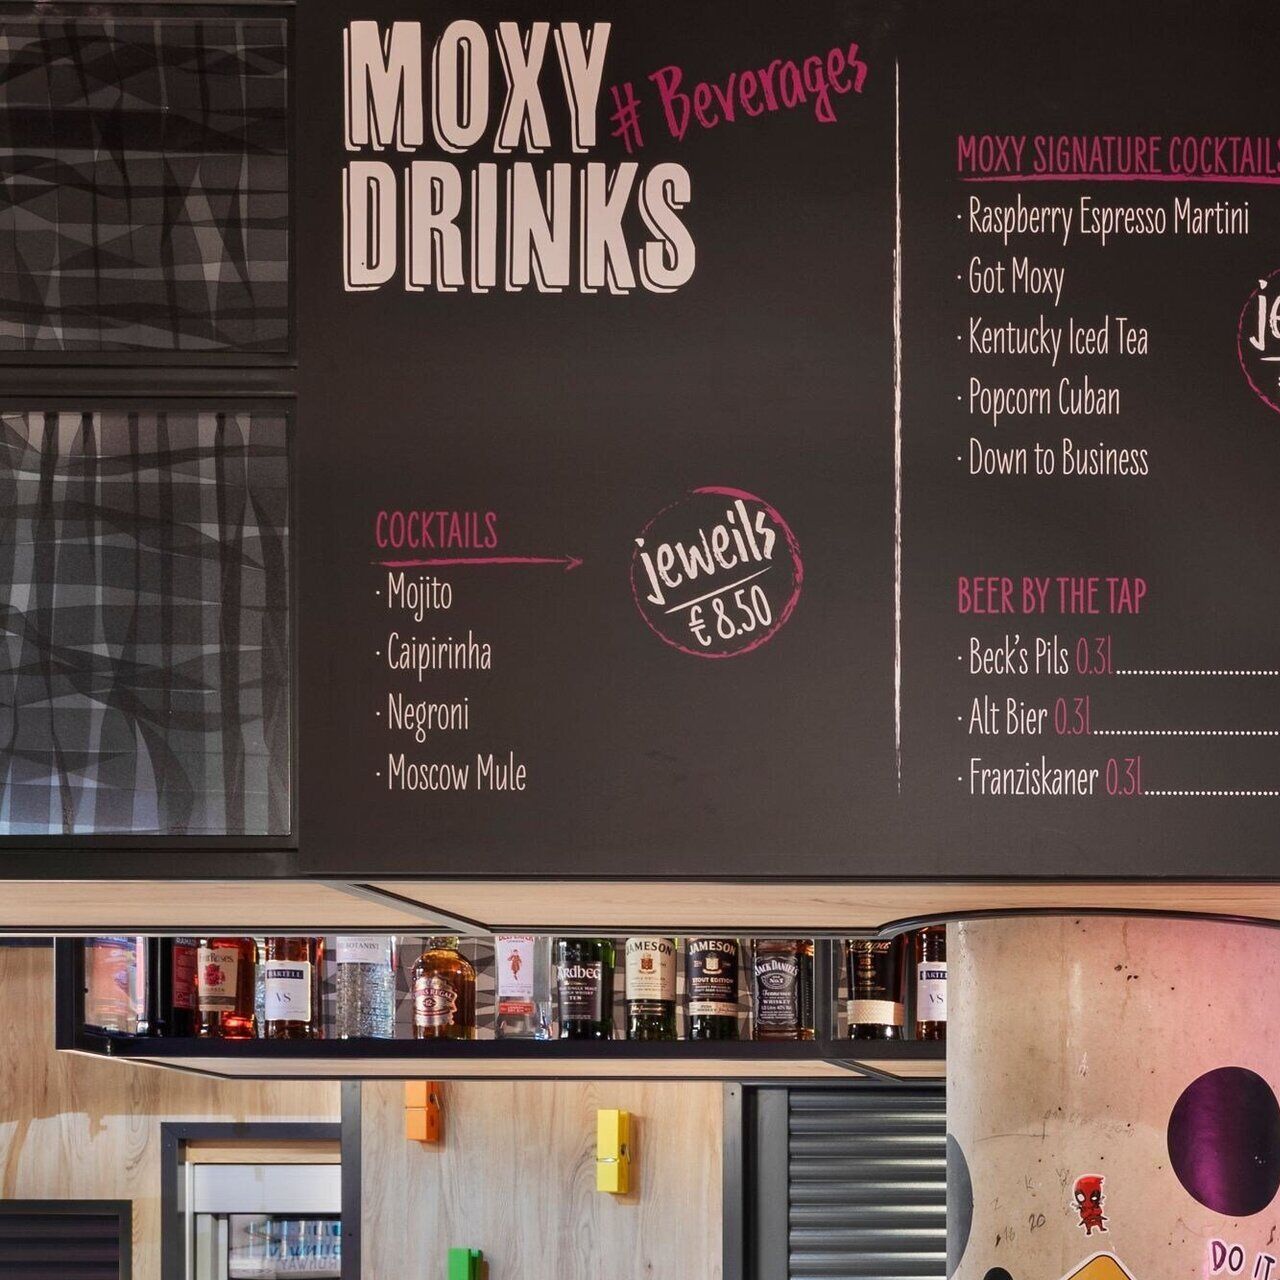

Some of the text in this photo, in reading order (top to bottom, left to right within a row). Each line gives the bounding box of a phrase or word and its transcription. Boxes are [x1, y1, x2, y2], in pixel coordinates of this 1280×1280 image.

[342, 19, 611, 154] MOXY
[649, 43, 867, 140] Beverages
[958, 136, 1025, 173] MOXY
[1033, 136, 1162, 173] SIGNATURE
[343, 161, 695, 295] DRINKS
[970, 194, 1248, 246] Raspberry Espresso Martini
[970, 315, 1147, 366] Kentucky Iced Tea
[970, 438, 1148, 475] Down to Business
[376, 511, 497, 548] COCKTAILS
[635, 500, 775, 605] jeweils
[388, 572, 452, 621] Mojito
[714, 584, 774, 639] 8.50
[959, 577, 1146, 614] BEER BY THE TAP
[388, 630, 491, 682] Caipirinha
[971, 635, 1028, 674] Beck's
[1036, 635, 1068, 674] Pils
[389, 693, 468, 743] Negroni
[389, 751, 526, 790] Moscow Mule
[627, 941, 673, 956] JAMESON
[690, 941, 735, 955] JAMESON
[755, 960, 799, 976] JACK DANIEL'S
[1212, 1241, 1243, 1272] DO
